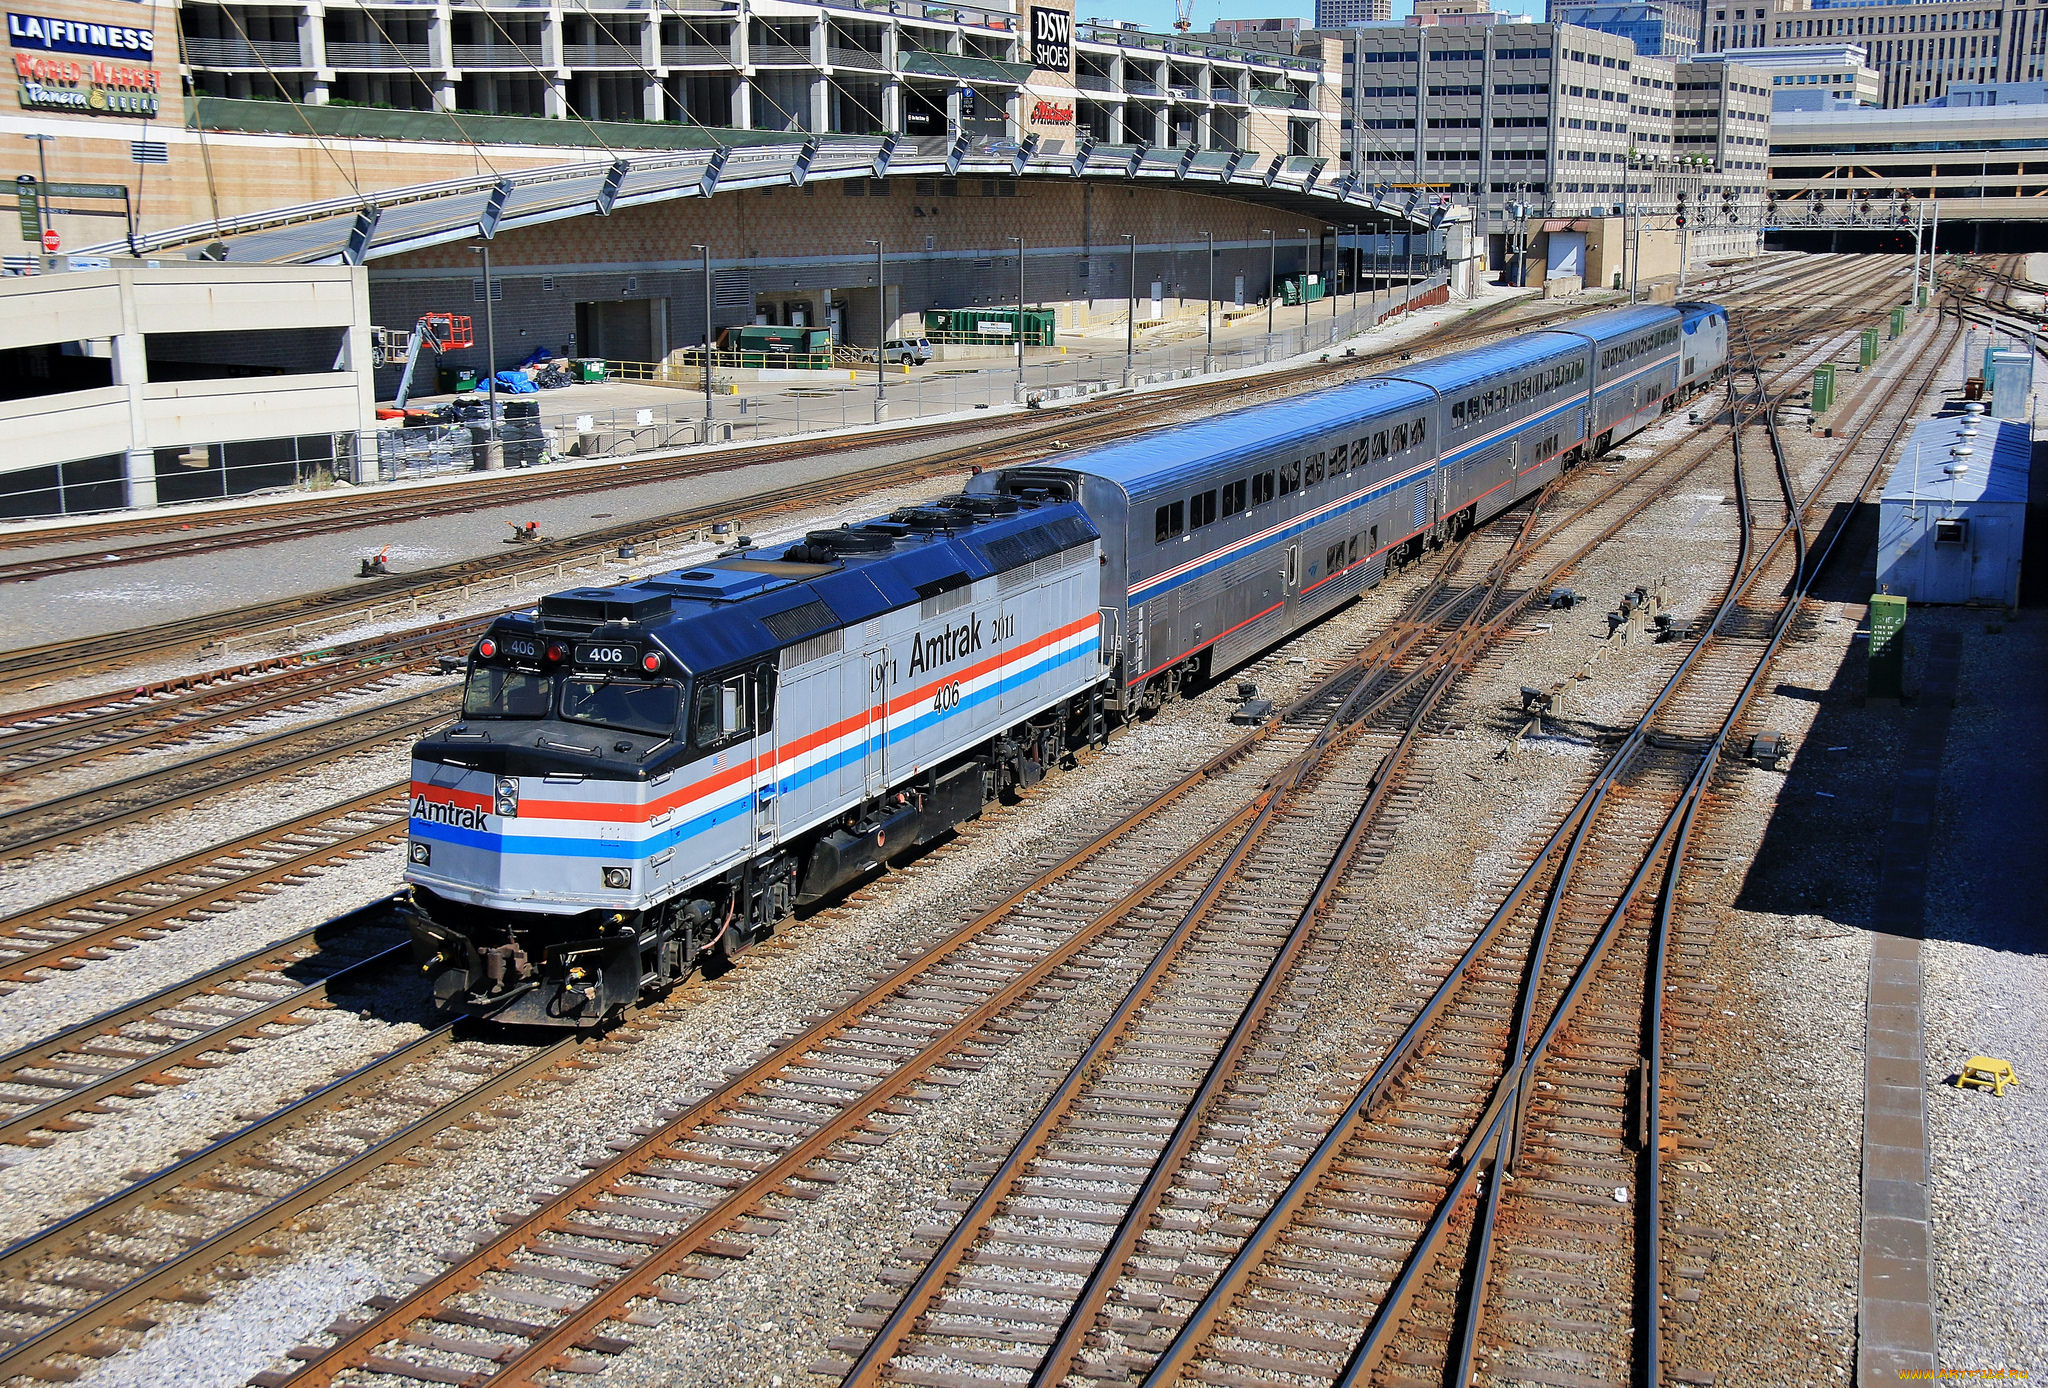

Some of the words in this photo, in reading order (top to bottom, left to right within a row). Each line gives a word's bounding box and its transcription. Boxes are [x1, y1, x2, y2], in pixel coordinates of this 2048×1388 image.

[9, 15, 44, 39] LA
[49, 19, 154, 51] FITNESS
[1037, 11, 1070, 43] DSW
[1037, 43, 1069, 67] SHOES
[15, 53, 82, 81] WORLD
[91, 61, 162, 89] MARKET
[25, 82, 87, 106] Panera
[108, 95, 159, 111] BREAD
[1033, 101, 1074, 121] Michaels
[44, 236, 60, 245] STOP
[511, 640, 535, 656] 406
[589, 648, 623, 662] 406
[908, 611, 982, 678] Amtrak
[991, 614, 1015, 644] 2011
[933, 681, 960, 714] 406
[412, 794, 488, 831] Amtrak
